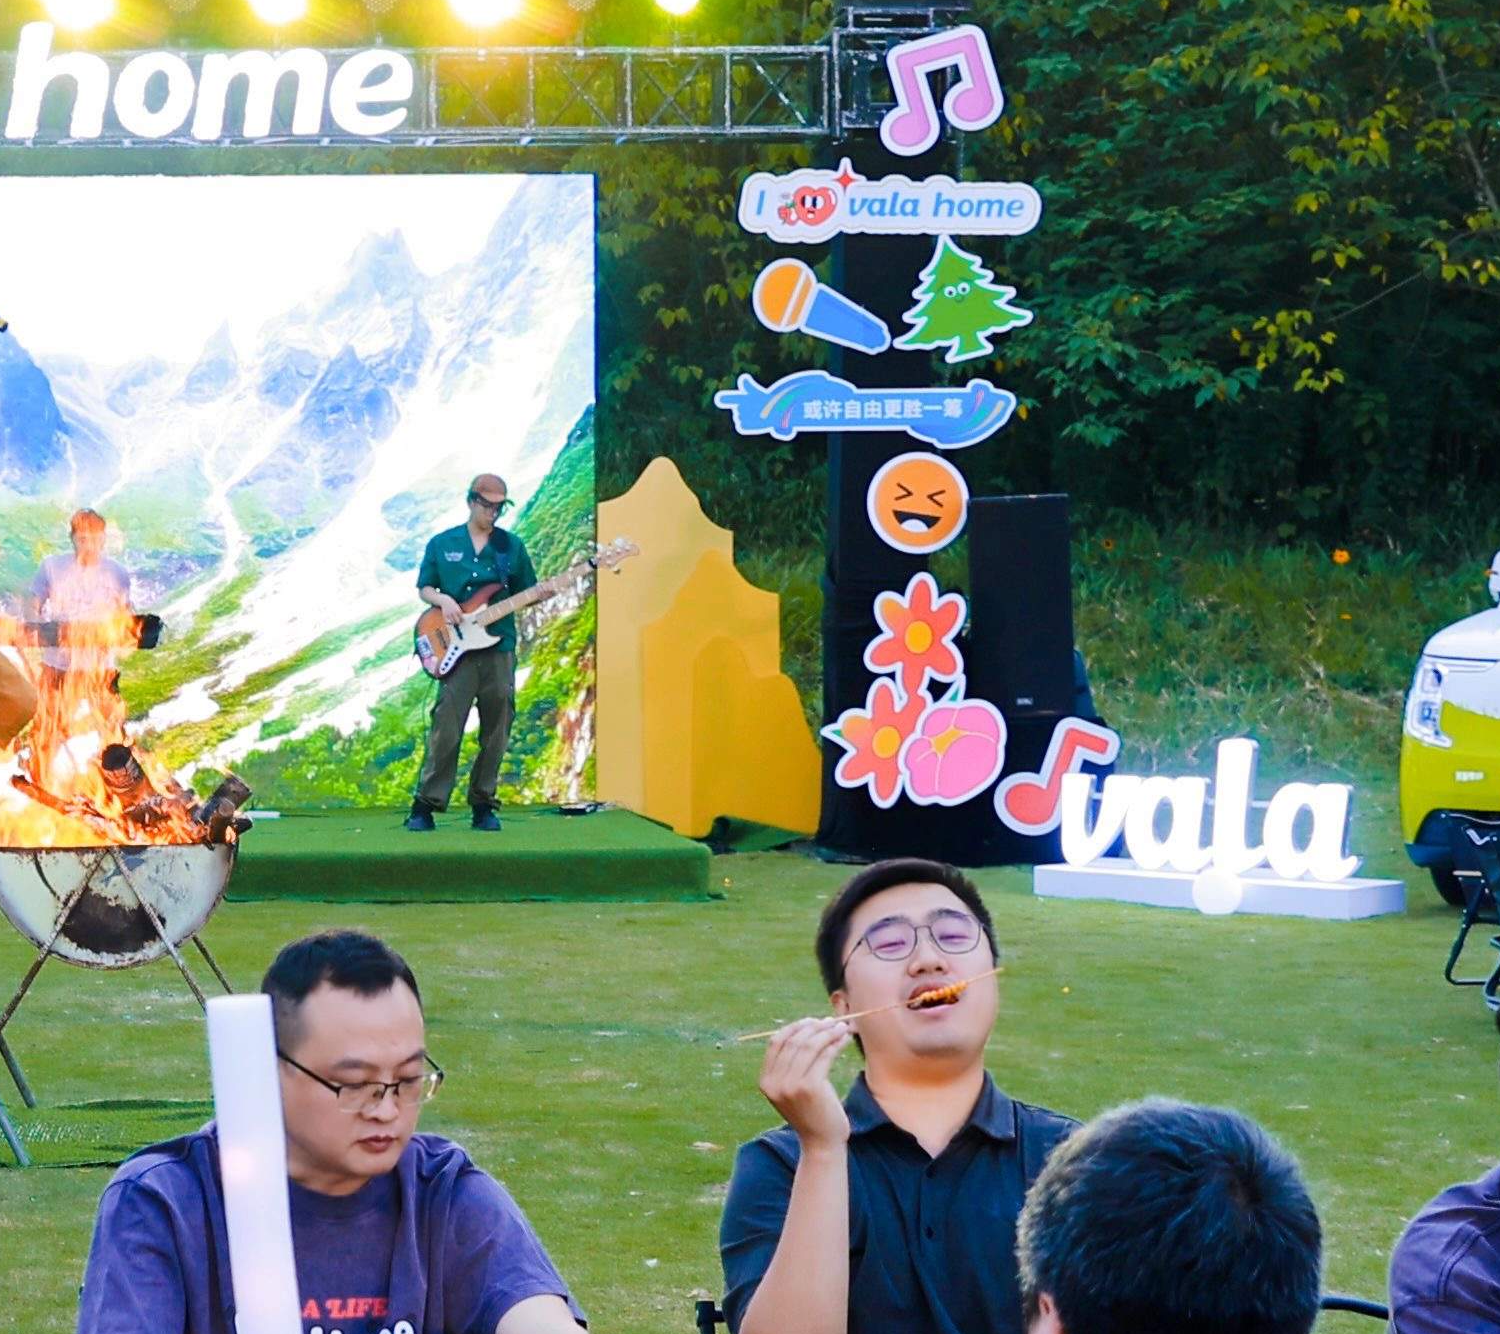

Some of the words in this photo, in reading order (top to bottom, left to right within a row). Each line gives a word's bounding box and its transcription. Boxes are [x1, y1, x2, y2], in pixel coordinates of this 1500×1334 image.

[5, 21, 415, 140] home
[755, 189, 766, 217] I
[847, 191, 921, 219] vala
[932, 190, 1025, 219] home
[803, 397, 964, 421] 或许自由更胜一筹
[1060, 738, 1363, 881] vala
[325, 1297, 389, 1319] LIFE
